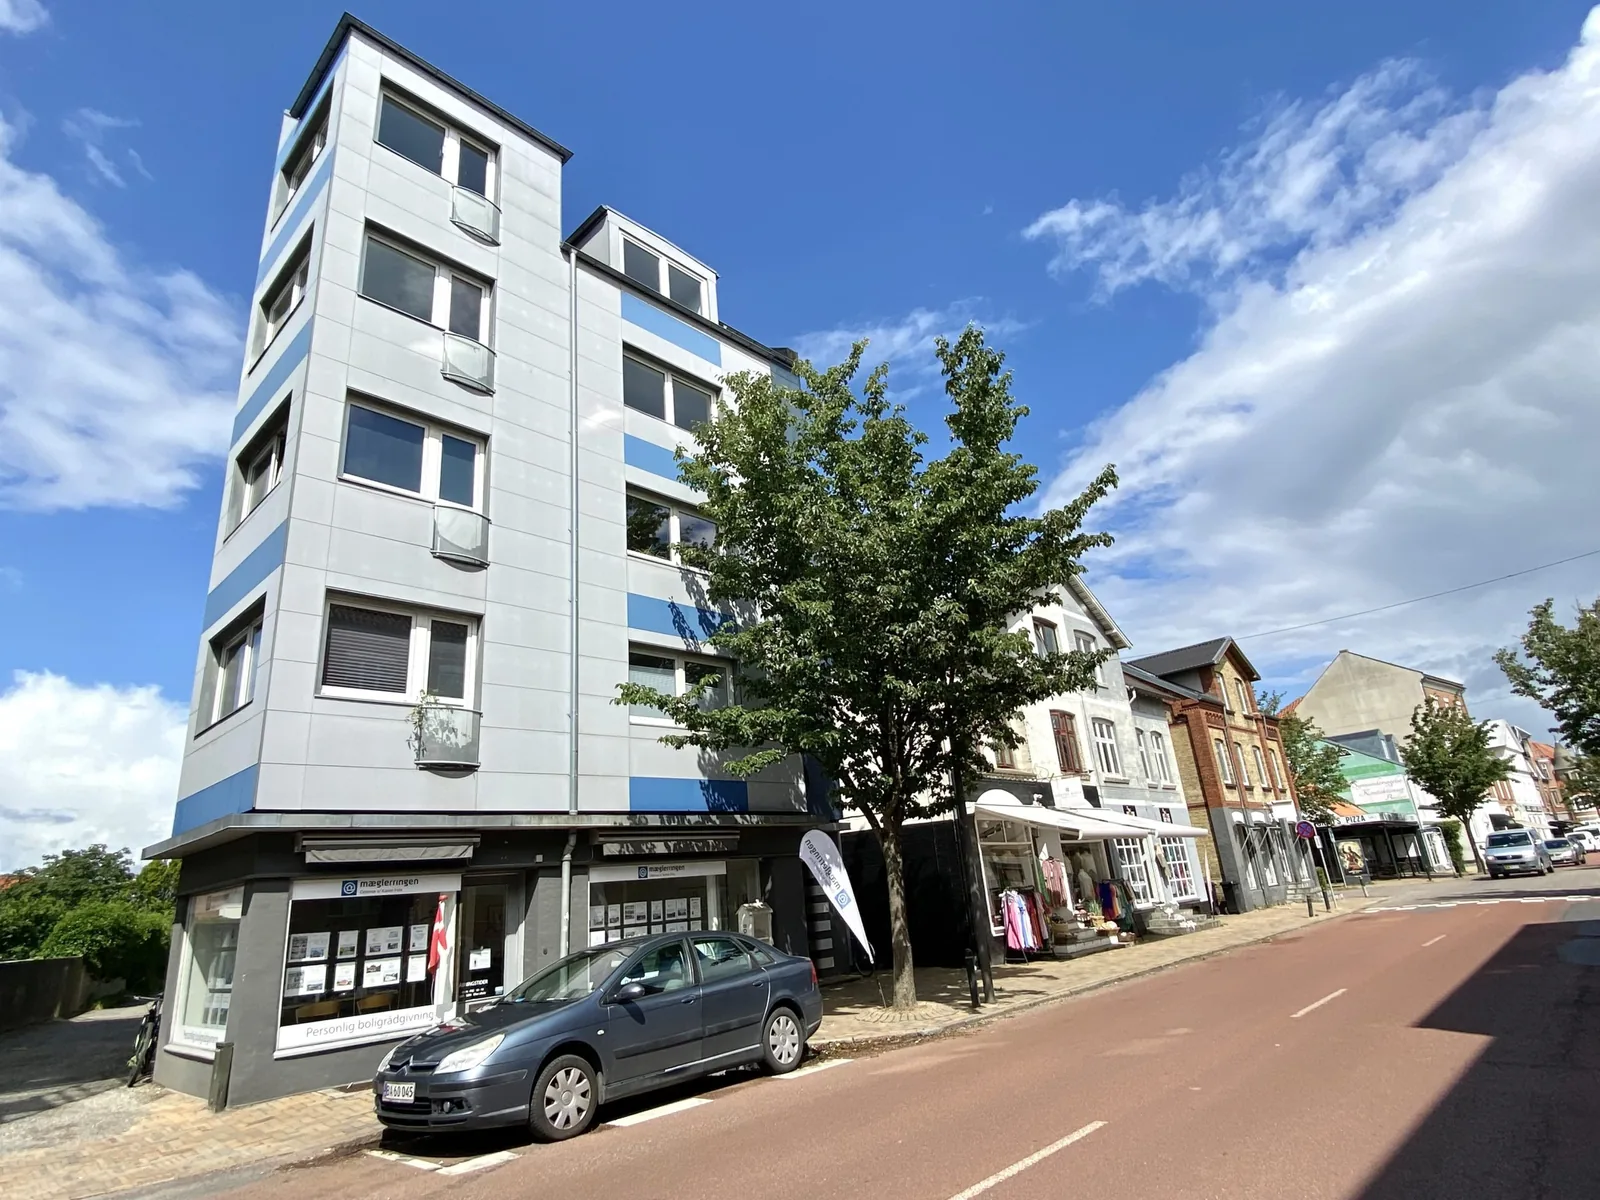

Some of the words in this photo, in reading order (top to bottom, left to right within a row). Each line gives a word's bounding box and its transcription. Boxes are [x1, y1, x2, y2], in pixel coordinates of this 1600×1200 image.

[1345, 815, 1366, 823] PIZZA
[360, 878, 419, 888] mæglerringen
[306, 1022, 355, 1038] Personlig
[357, 1011, 434, 1029] boligrådgivning
[394, 1086, 401, 1097] 60
[402, 1086, 413, 1098] 045
